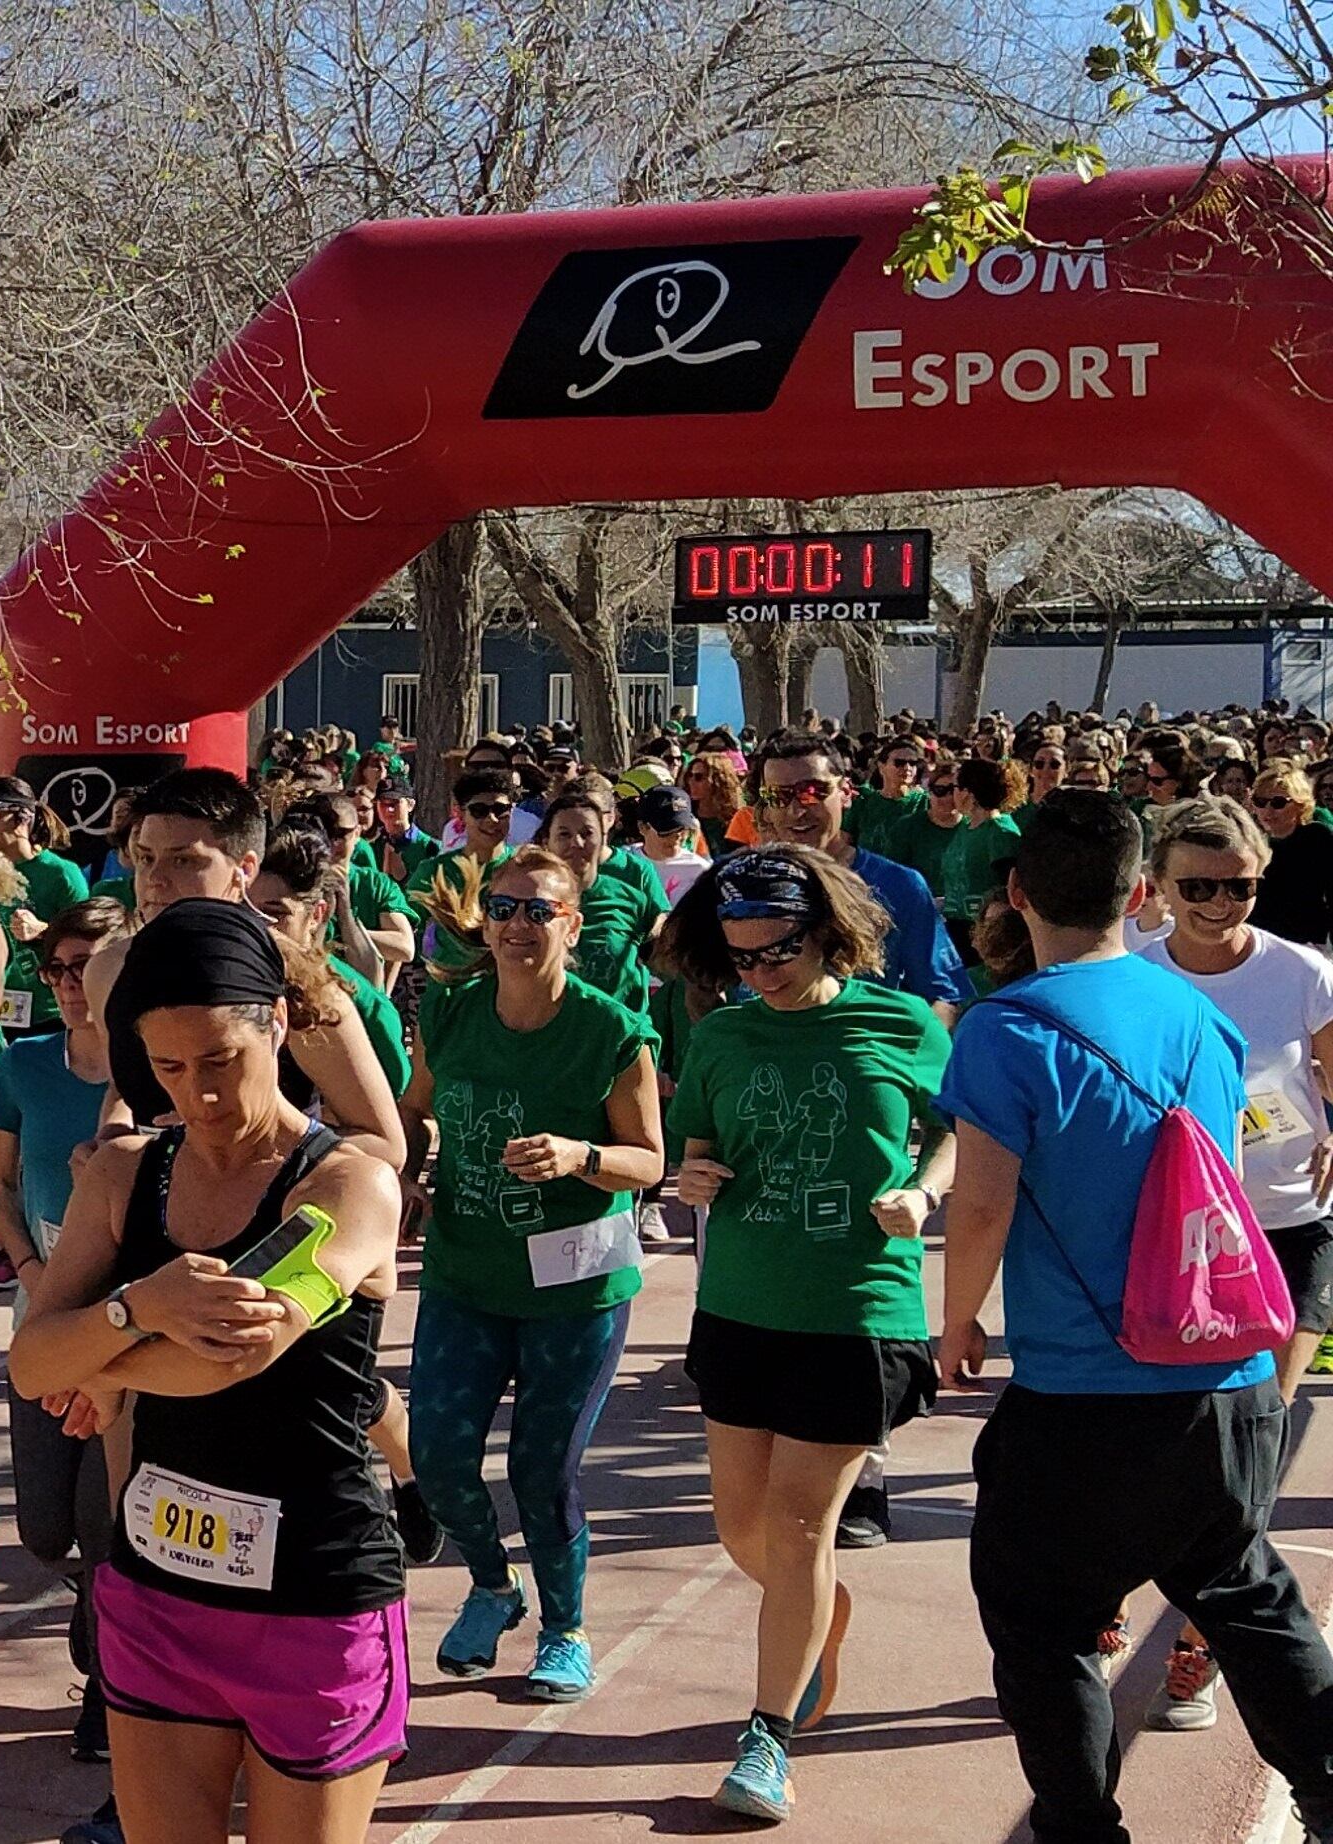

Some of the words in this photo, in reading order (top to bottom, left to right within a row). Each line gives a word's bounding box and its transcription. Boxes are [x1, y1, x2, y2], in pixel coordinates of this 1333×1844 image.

[853, 329, 1160, 409] ESPORT
[690, 542, 913, 596] 00:00:11
[726, 606, 780, 623] SOM
[789, 602, 882, 621] ESPORT
[21, 714, 79, 744] SOM
[95, 715, 191, 745] ESPORT
[176, 1484, 211, 1503] NICOLA
[165, 1502, 216, 1550] 918
